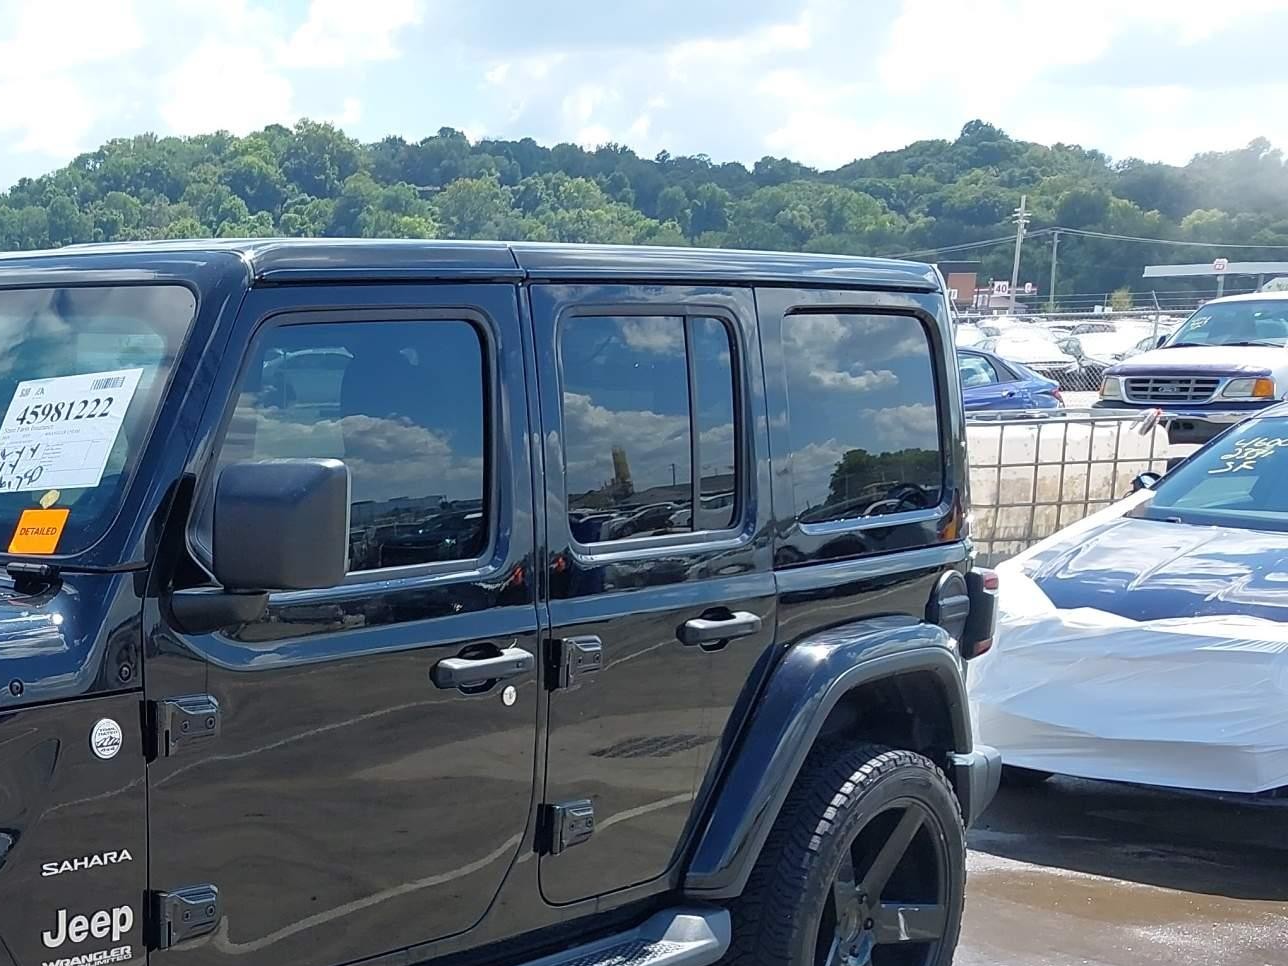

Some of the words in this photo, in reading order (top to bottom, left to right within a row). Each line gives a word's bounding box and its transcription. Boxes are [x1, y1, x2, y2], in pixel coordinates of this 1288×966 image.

[16, 397, 114, 426] 45981222
[19, 527, 58, 536] DETAILED
[41, 849, 133, 876] SAHARA
[42, 905, 134, 948] Jeep
